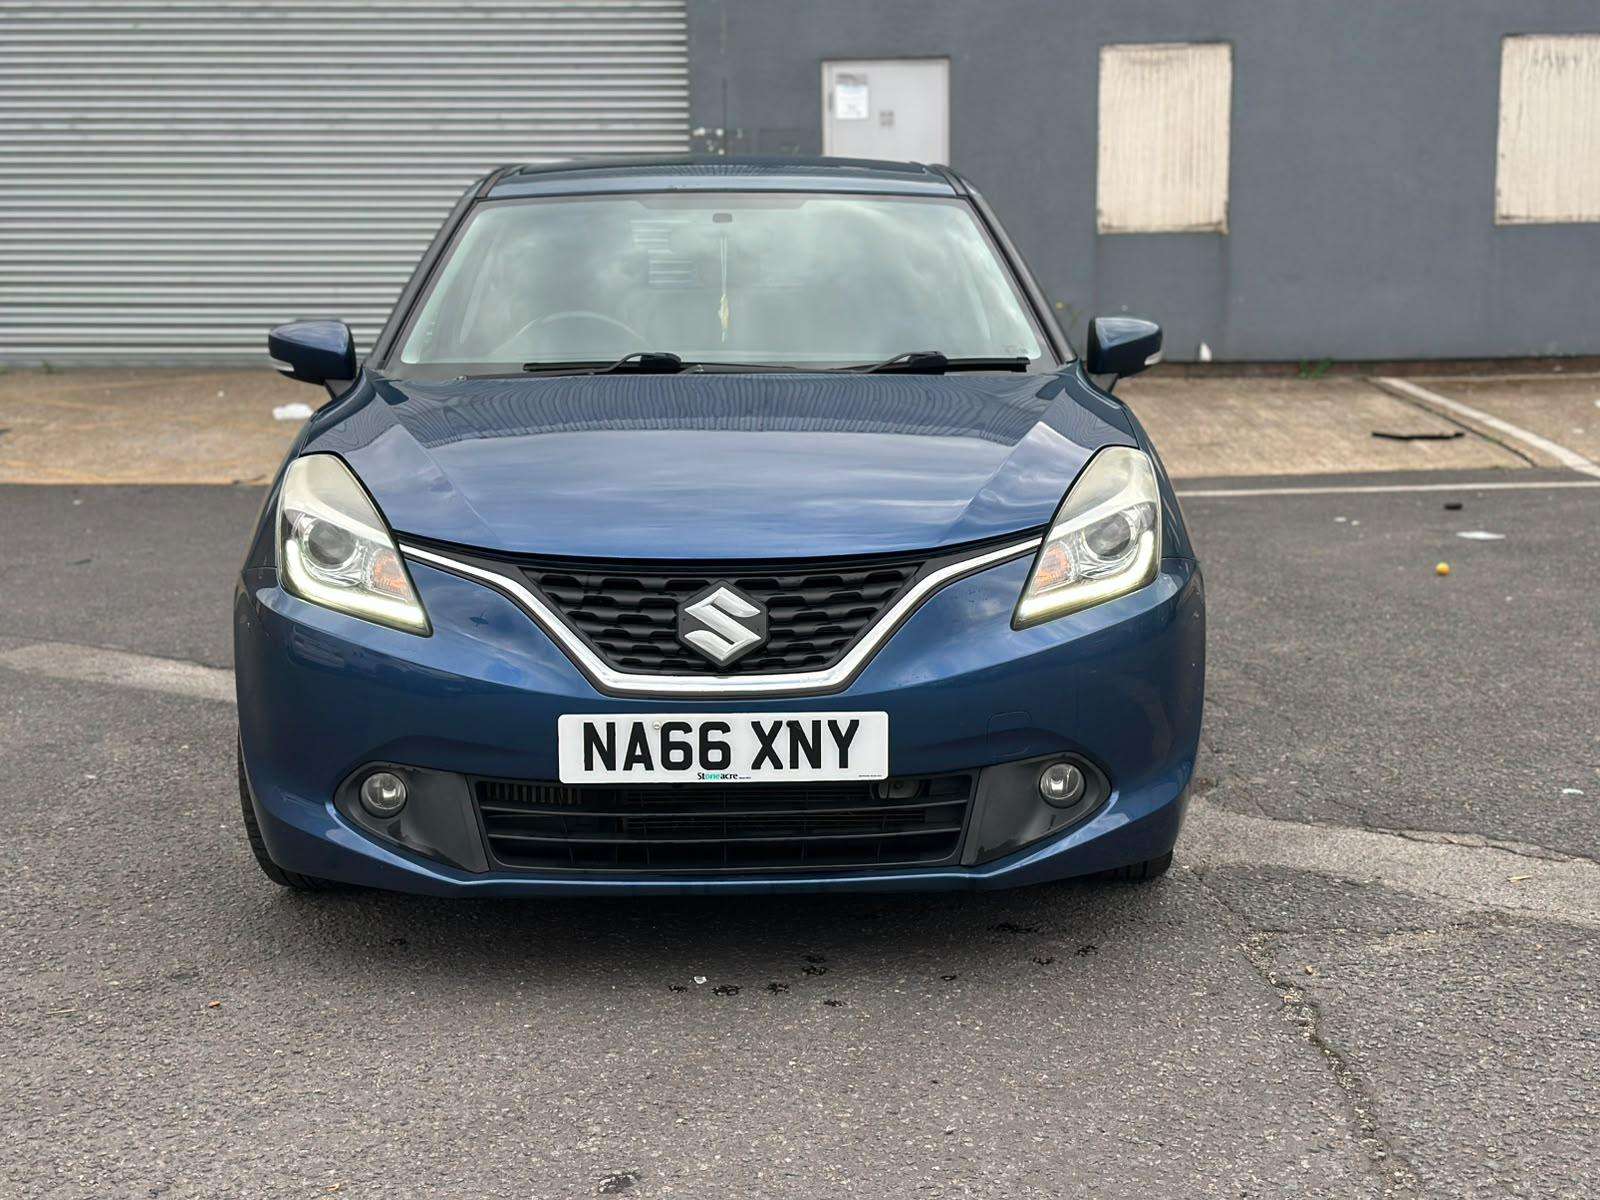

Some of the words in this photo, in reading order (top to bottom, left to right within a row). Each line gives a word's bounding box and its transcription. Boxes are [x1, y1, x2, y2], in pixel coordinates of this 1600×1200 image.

[583, 721, 732, 771] NA66
[750, 719, 860, 770] XNY
[697, 772, 738, 780] Stoneacre
